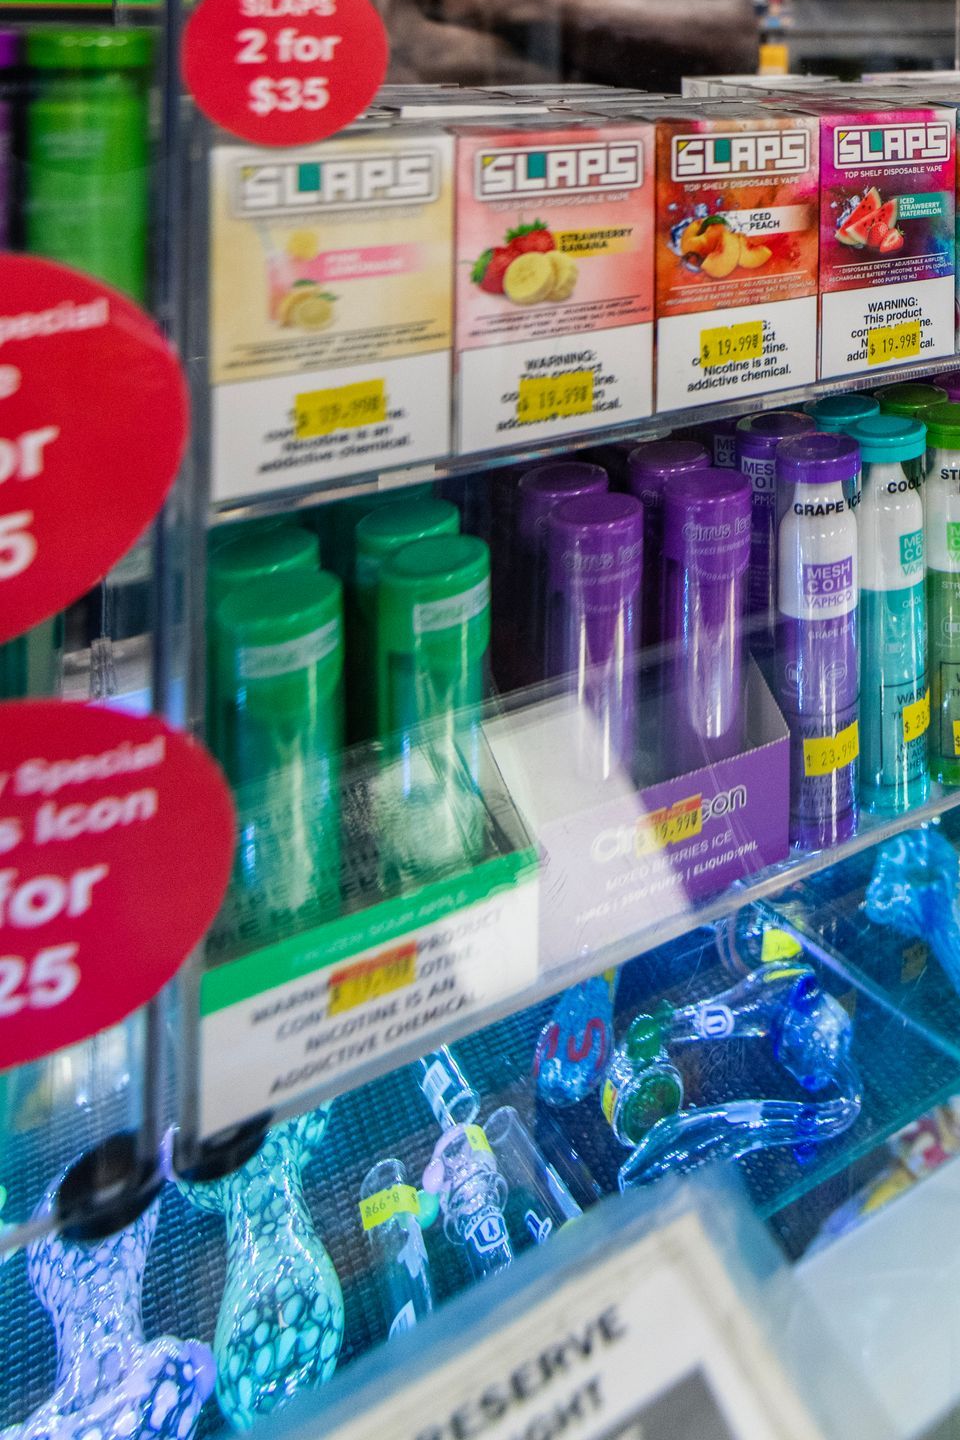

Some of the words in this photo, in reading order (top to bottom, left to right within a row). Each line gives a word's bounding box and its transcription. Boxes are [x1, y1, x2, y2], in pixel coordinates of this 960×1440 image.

[235, 31, 267, 64] 2
[276, 29, 341, 63] for
[248, 75, 330, 116] $35
[838, 126, 948, 164] SLAPS
[677, 135, 806, 176] SLAPS
[481, 144, 640, 194] SLAPS
[844, 171, 859, 179] TOP
[860, 169, 882, 178] SHELF
[883, 166, 925, 176] DISPOSABLE
[926, 164, 943, 173] VAPE
[242, 157, 435, 211] SLAPS
[900, 197, 915, 205] ICED
[900, 201, 940, 211] STRAWBERRY
[750, 212, 772, 222] ICED
[900, 208, 942, 218] WATERMELON
[750, 219, 781, 231] PEACH
[868, 297, 918, 313] WARNING:
[887, 477, 921, 494] COOL
[793, 500, 844, 517] GRAPE
[848, 490, 862, 510] ICE
[806, 563, 851, 580] MESH
[806, 576, 851, 592] COIL
[15, 734, 166, 797] Special
[711, 829, 734, 850] ICE
